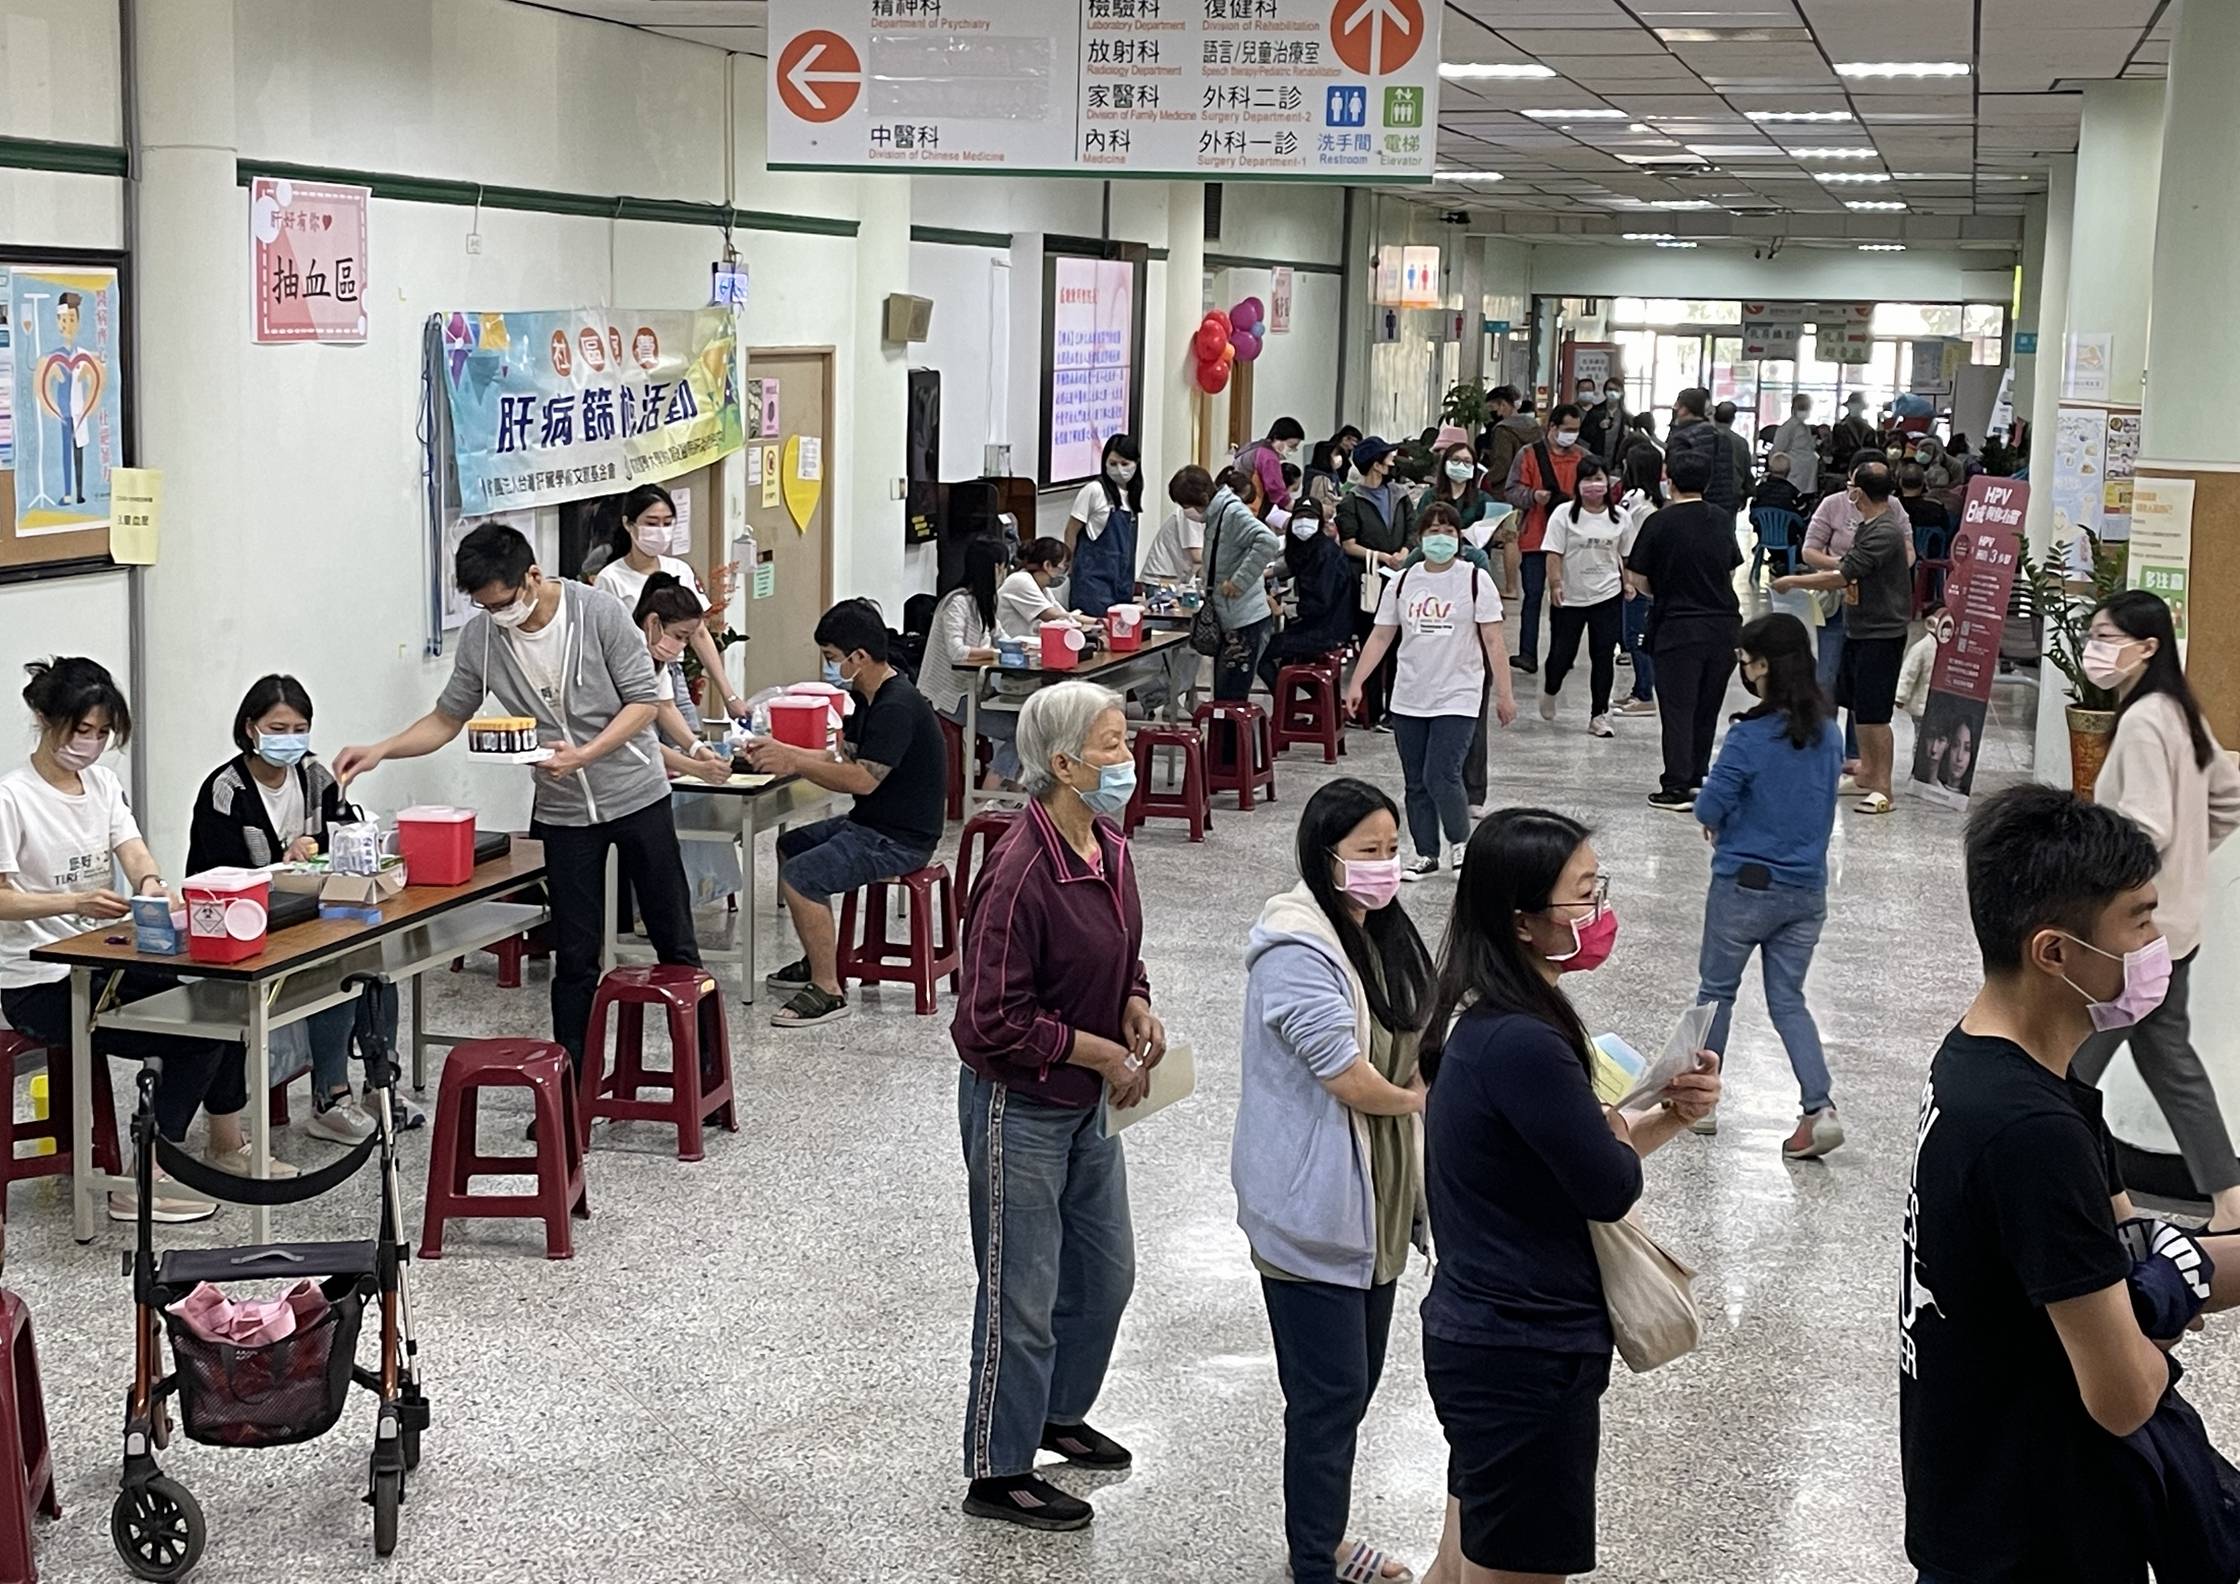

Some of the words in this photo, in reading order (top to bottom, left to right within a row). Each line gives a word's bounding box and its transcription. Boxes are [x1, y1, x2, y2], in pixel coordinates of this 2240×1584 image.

[872, 0, 942, 17] 精神科
[1088, 0, 1160, 19] 檢驗科
[1204, 0, 1278, 19] 復健科
[871, 18, 926, 29] Department
[928, 18, 938, 28] of
[940, 18, 992, 31] Psychiatry
[1087, 20, 1133, 32] Laboratory
[1134, 20, 1186, 32] Department
[1202, 20, 1240, 31] Division
[1242, 20, 1252, 31] of
[1255, 20, 1321, 31] Rehabilitation
[1087, 39, 1160, 64] 放射科
[1203, 40, 1320, 65] 語言/兒童治療室
[1087, 66, 1129, 78] Radiology
[1131, 66, 1183, 77] Department
[1087, 84, 1160, 109] 家醫科
[1202, 85, 1303, 110] 外科二診
[1086, 108, 1119, 121] Division
[1120, 109, 1129, 121] of
[1130, 109, 1158, 123] Family
[1159, 110, 1197, 121] Medicine
[1201, 111, 1239, 124] Surgery
[1243, 111, 1312, 123] Department-2
[871, 124, 940, 149] 中醫科
[1085, 129, 1131, 153] 內科
[1199, 130, 1299, 156] 外科一診
[1317, 133, 1372, 153] 洗手間
[1383, 134, 1421, 153] 電梯
[868, 149, 907, 161] Division
[909, 150, 919, 161] of
[921, 150, 960, 162] Chinese
[962, 151, 1005, 162] Medicine
[1082, 154, 1127, 165] Medicine
[1198, 155, 1235, 168] Surgery
[1239, 155, 1307, 168] Department-1
[1320, 154, 1368, 165] Restroom
[1380, 156, 1423, 166] Elevator
[272, 255, 358, 305] 抽血區
[1984, 486, 2013, 505] HPV
